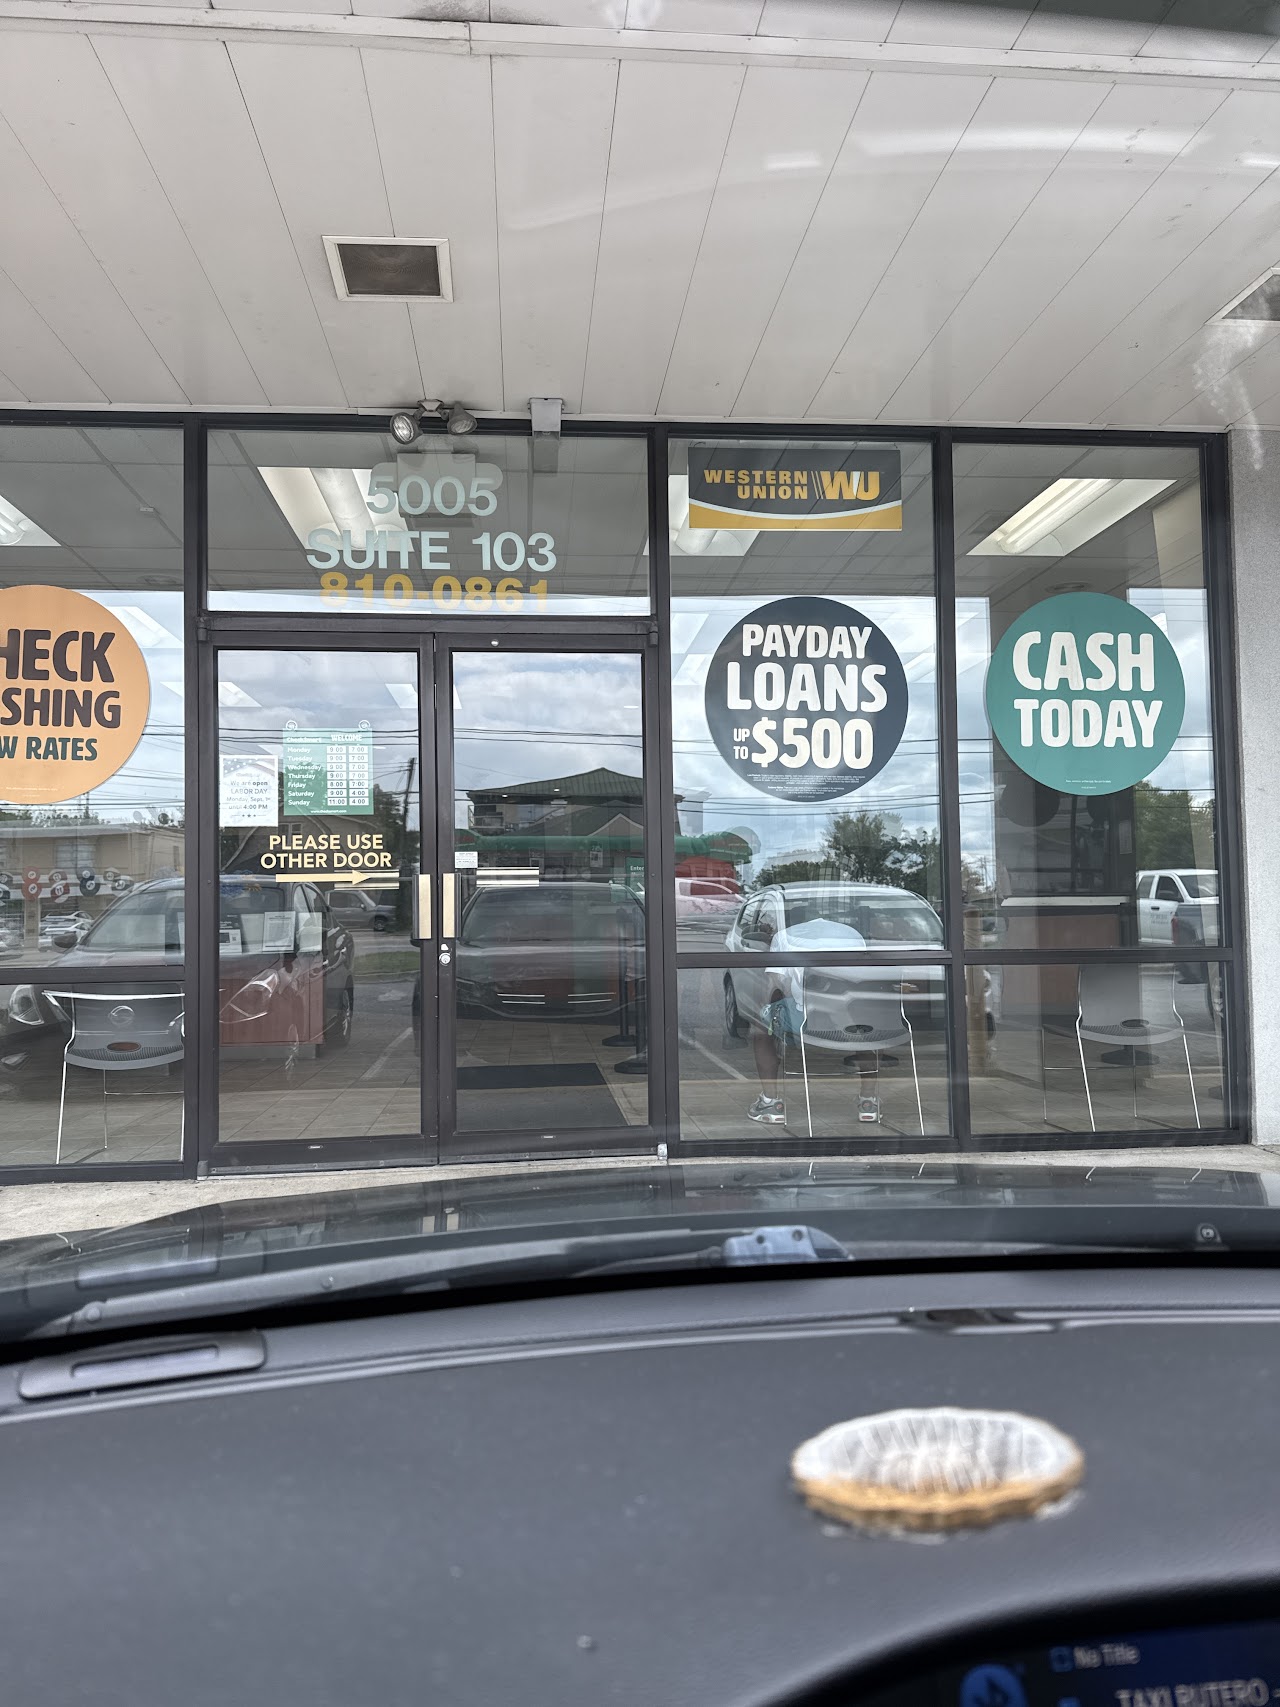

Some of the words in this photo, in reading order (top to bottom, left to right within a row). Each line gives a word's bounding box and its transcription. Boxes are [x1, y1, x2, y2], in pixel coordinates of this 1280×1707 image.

[703, 469, 808, 484] WESTERN
[366, 475, 498, 516] 5005
[737, 485, 808, 500] UNION
[306, 528, 450, 570] SUITE
[472, 531, 557, 573] 103
[319, 571, 548, 612] 810-0861
[742, 624, 873, 659] PAYDAY
[1012, 631, 1155, 692] CASH
[727, 662, 888, 713] LOANS
[1013, 698, 1163, 748] TODAY
[330, 734, 363, 742] WELCOME
[733, 728, 750, 742] UP
[752, 716, 874, 770] $500
[26, 736, 98, 761] RATES
[287, 746, 311, 754] Monday
[288, 755, 312, 763] Tuesday
[733, 745, 749, 760] TO
[269, 834, 341, 850] PLEASE
[347, 834, 384, 850] USE
[260, 853, 328, 869] OTHER
[333, 852, 392, 868] DOOR
